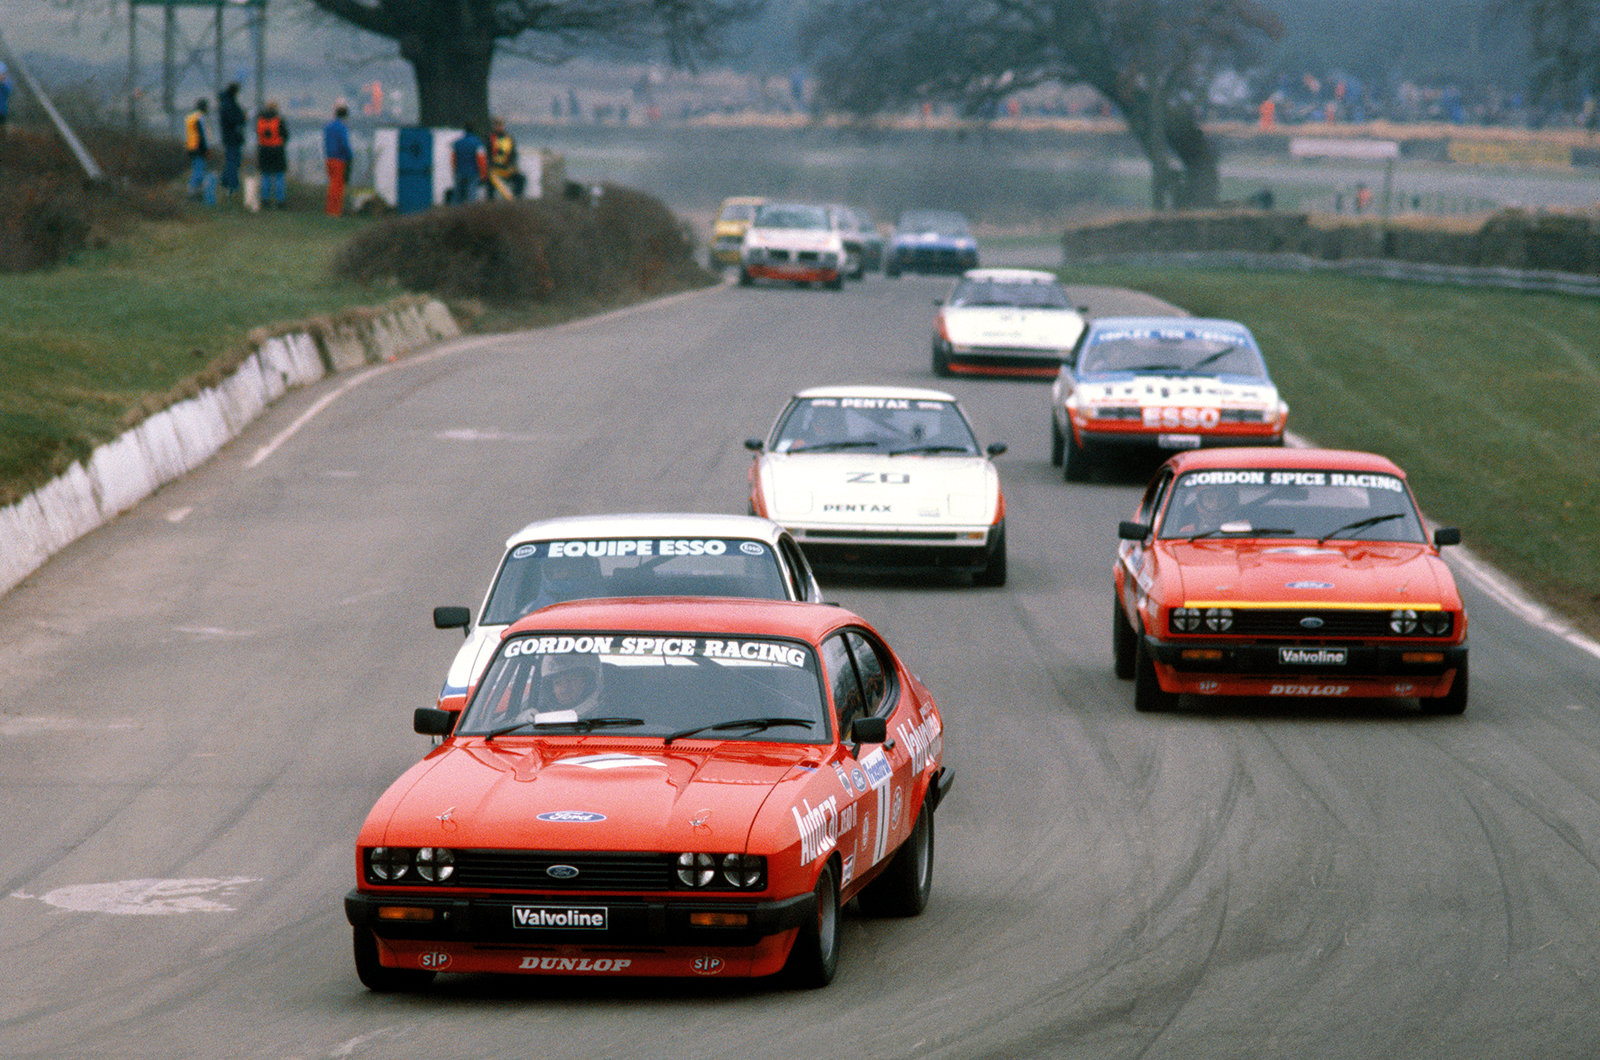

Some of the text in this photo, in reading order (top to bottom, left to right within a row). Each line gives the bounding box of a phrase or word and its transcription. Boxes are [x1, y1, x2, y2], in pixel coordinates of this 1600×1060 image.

[841, 398, 909, 410] PENTAX
[1142, 406, 1220, 429] ESSO
[1269, 472, 1326, 485] SPICE
[1330, 473, 1402, 493] RACING
[823, 504, 891, 512] PENTAX
[547, 539, 727, 558] EQUIPE ESSO
[504, 636, 806, 668] GORDON SPICE RACING
[1282, 649, 1345, 663] Valvoline
[1269, 684, 1350, 696] DUNLOP
[791, 794, 838, 868] Autocar
[516, 909, 604, 926] Valvoline
[422, 952, 448, 967] STP
[518, 957, 632, 971] DUNLOP
[693, 956, 720, 970] STP
